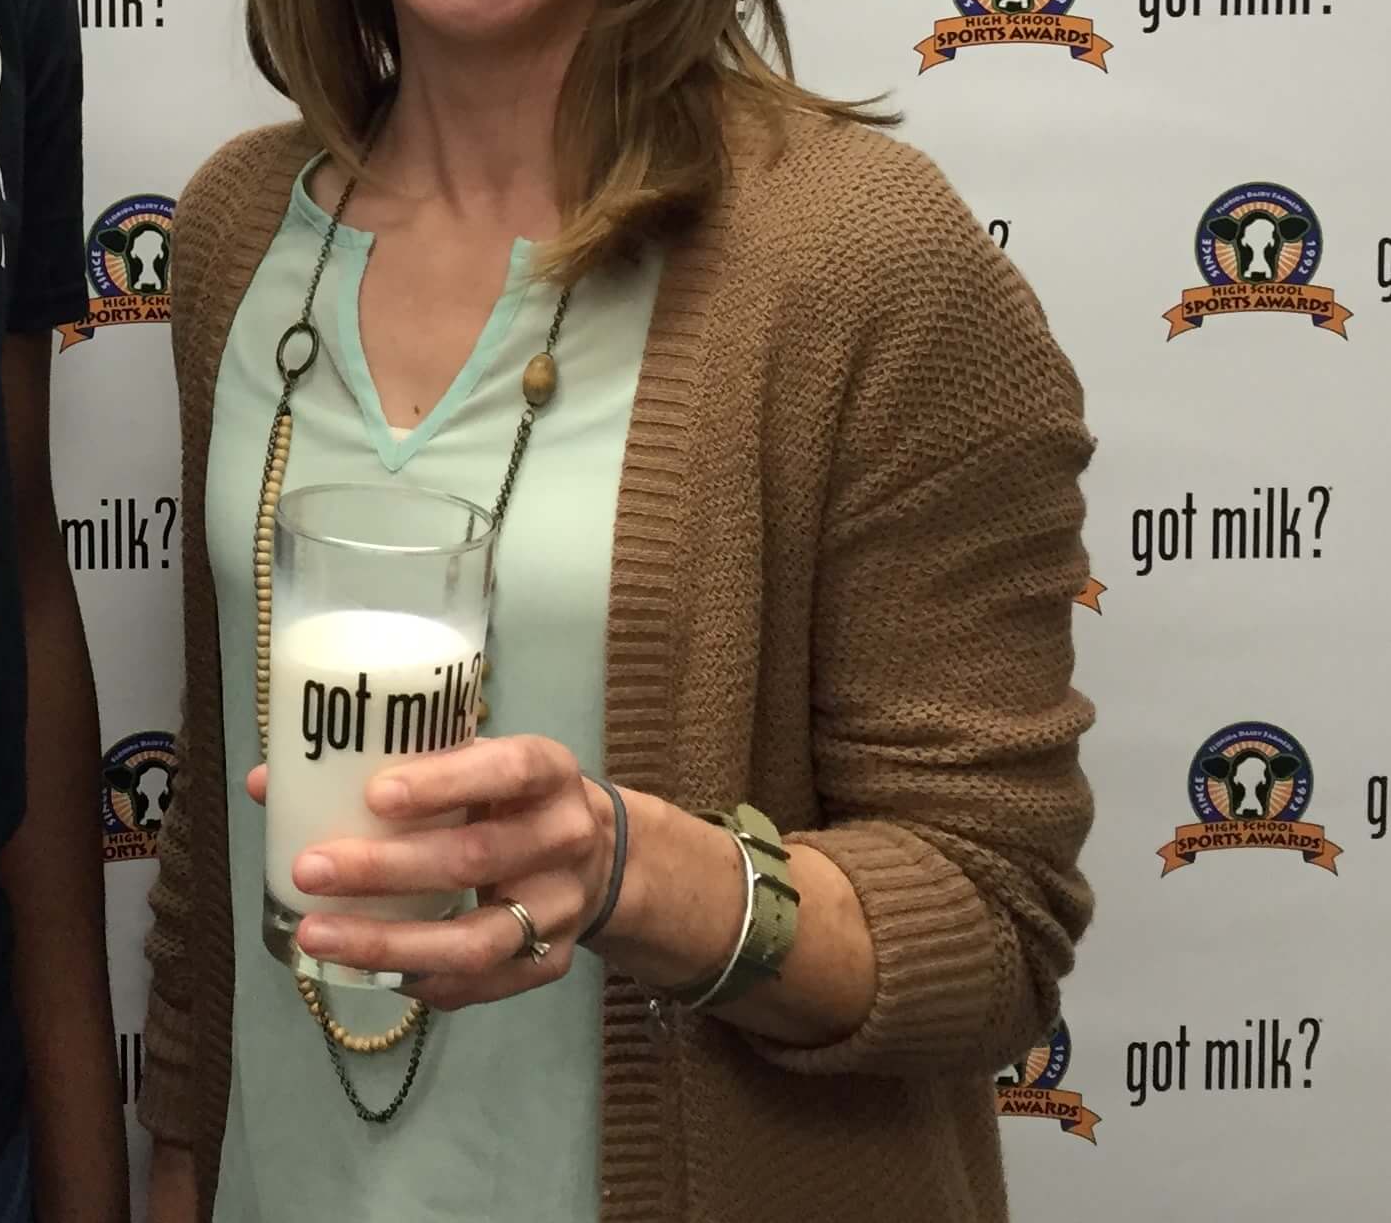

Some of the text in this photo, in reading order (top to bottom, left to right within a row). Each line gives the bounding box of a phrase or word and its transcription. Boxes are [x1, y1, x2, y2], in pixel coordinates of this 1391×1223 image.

[966, 15, 1061, 27] HIGH SCHOOL
[937, 26, 1090, 47] SPORTS AWARDS
[1212, 285, 1303, 296] HIGH SCHOOL
[1185, 296, 1330, 314] SPORTS AWARDS
[61, 497, 178, 570] milk?
[1132, 486, 1330, 576] got milk?
[303, 651, 480, 760] got milk?
[1205, 822, 1294, 833] HIGH SCHOOL
[1178, 832, 1321, 851] SPORTS AWARDS
[1127, 1018, 1320, 1107] got milk?
[998, 1090, 1051, 1100] SCHOOL
[1002, 1101, 1080, 1116] AWARDS
